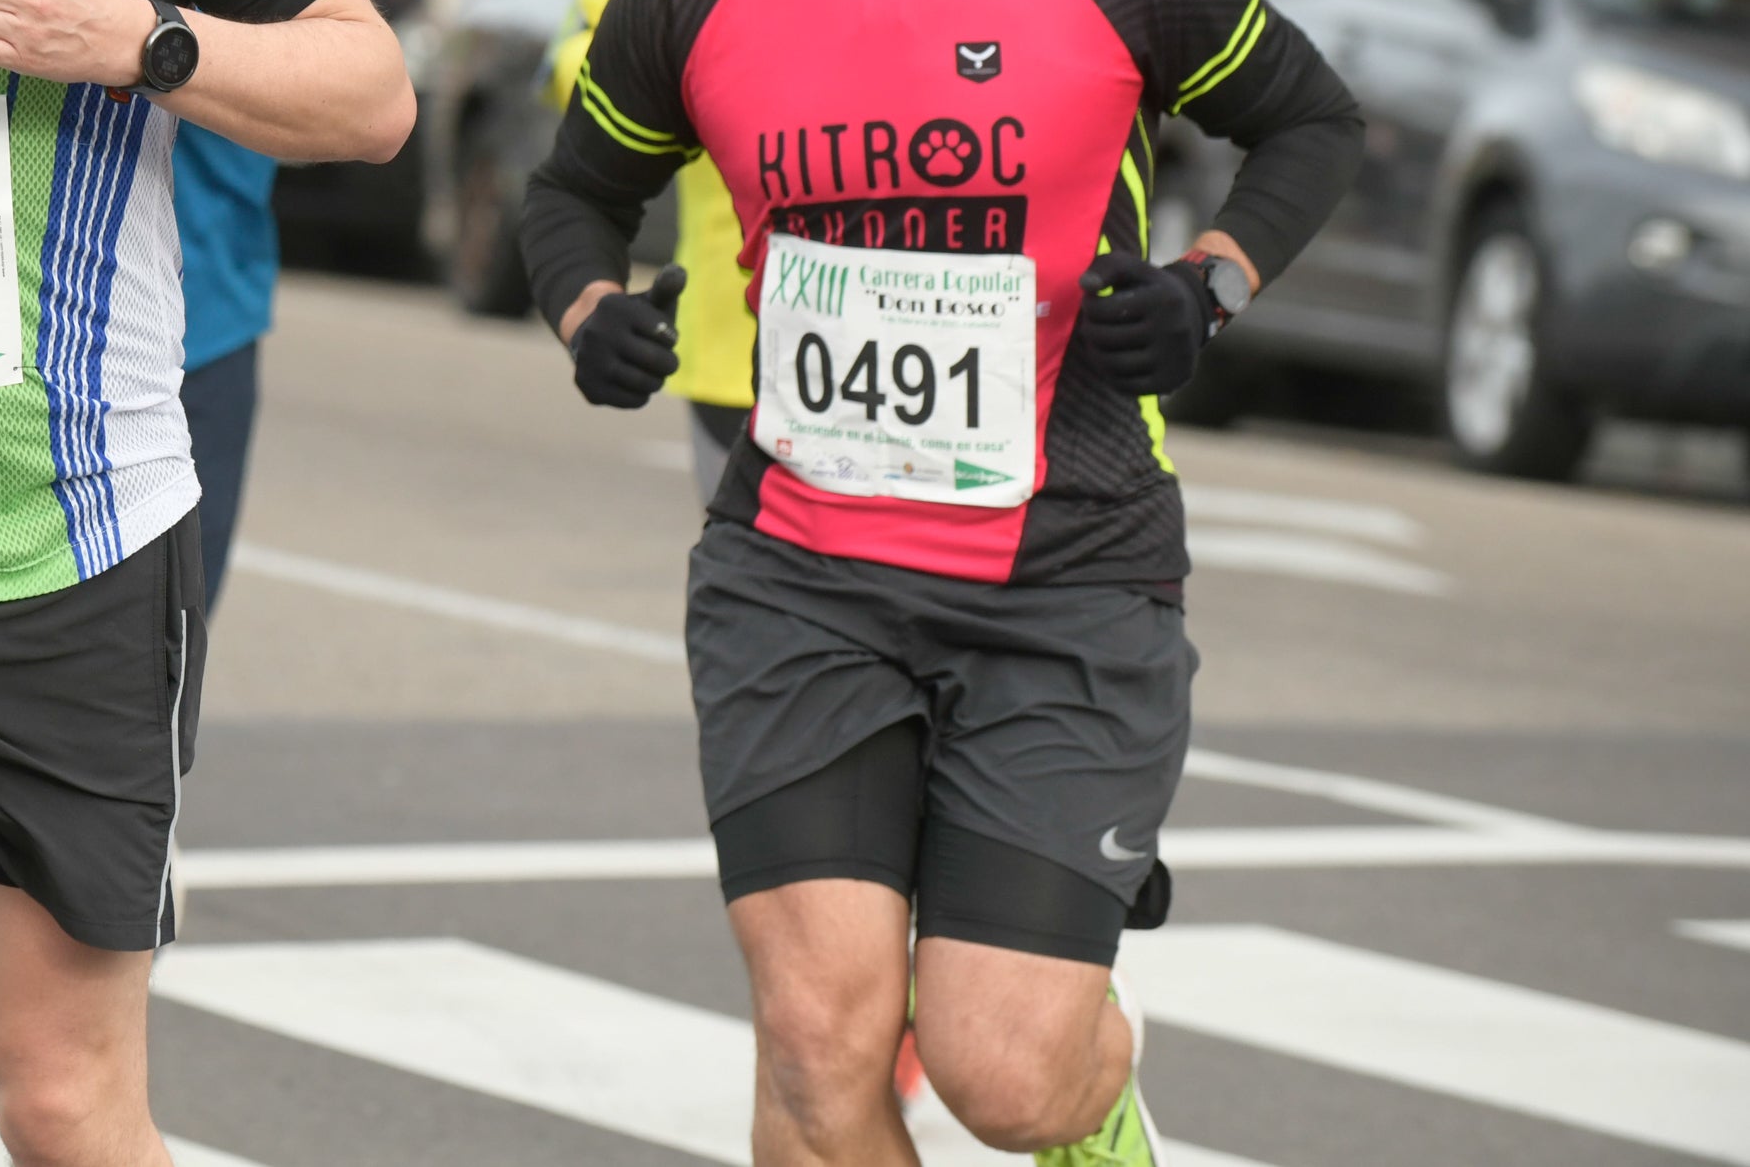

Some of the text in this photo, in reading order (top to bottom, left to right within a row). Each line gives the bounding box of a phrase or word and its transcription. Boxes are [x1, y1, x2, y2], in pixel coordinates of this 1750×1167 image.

[769, 251, 849, 317] XXIII
[859, 265, 1024, 295] Carrera Popular
[795, 332, 981, 429] 0491
